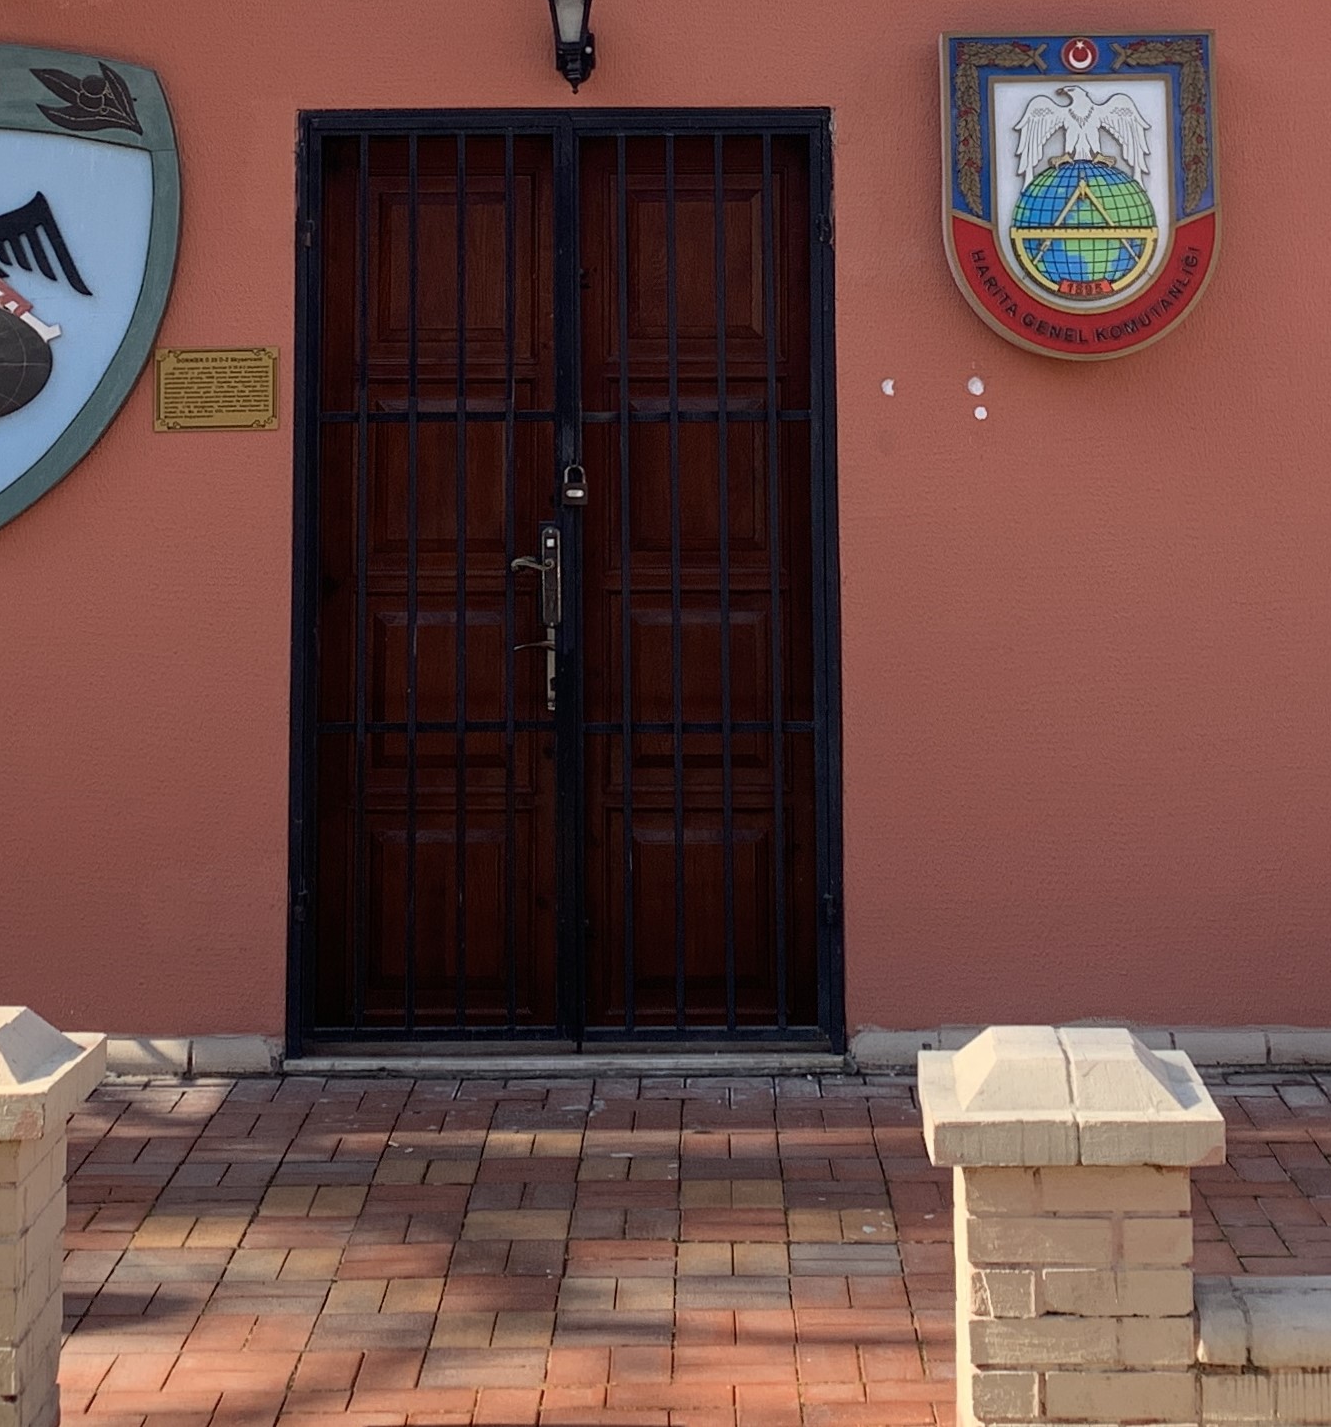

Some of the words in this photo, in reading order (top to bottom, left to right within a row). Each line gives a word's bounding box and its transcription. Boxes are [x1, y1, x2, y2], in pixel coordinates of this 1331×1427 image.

[970, 249, 1019, 318] HARİTA
[1021, 312, 1089, 343] GENEL
[1094, 246, 1201, 343] KOMUTANLIĞI
[1067, 282, 1103, 295] 1895
